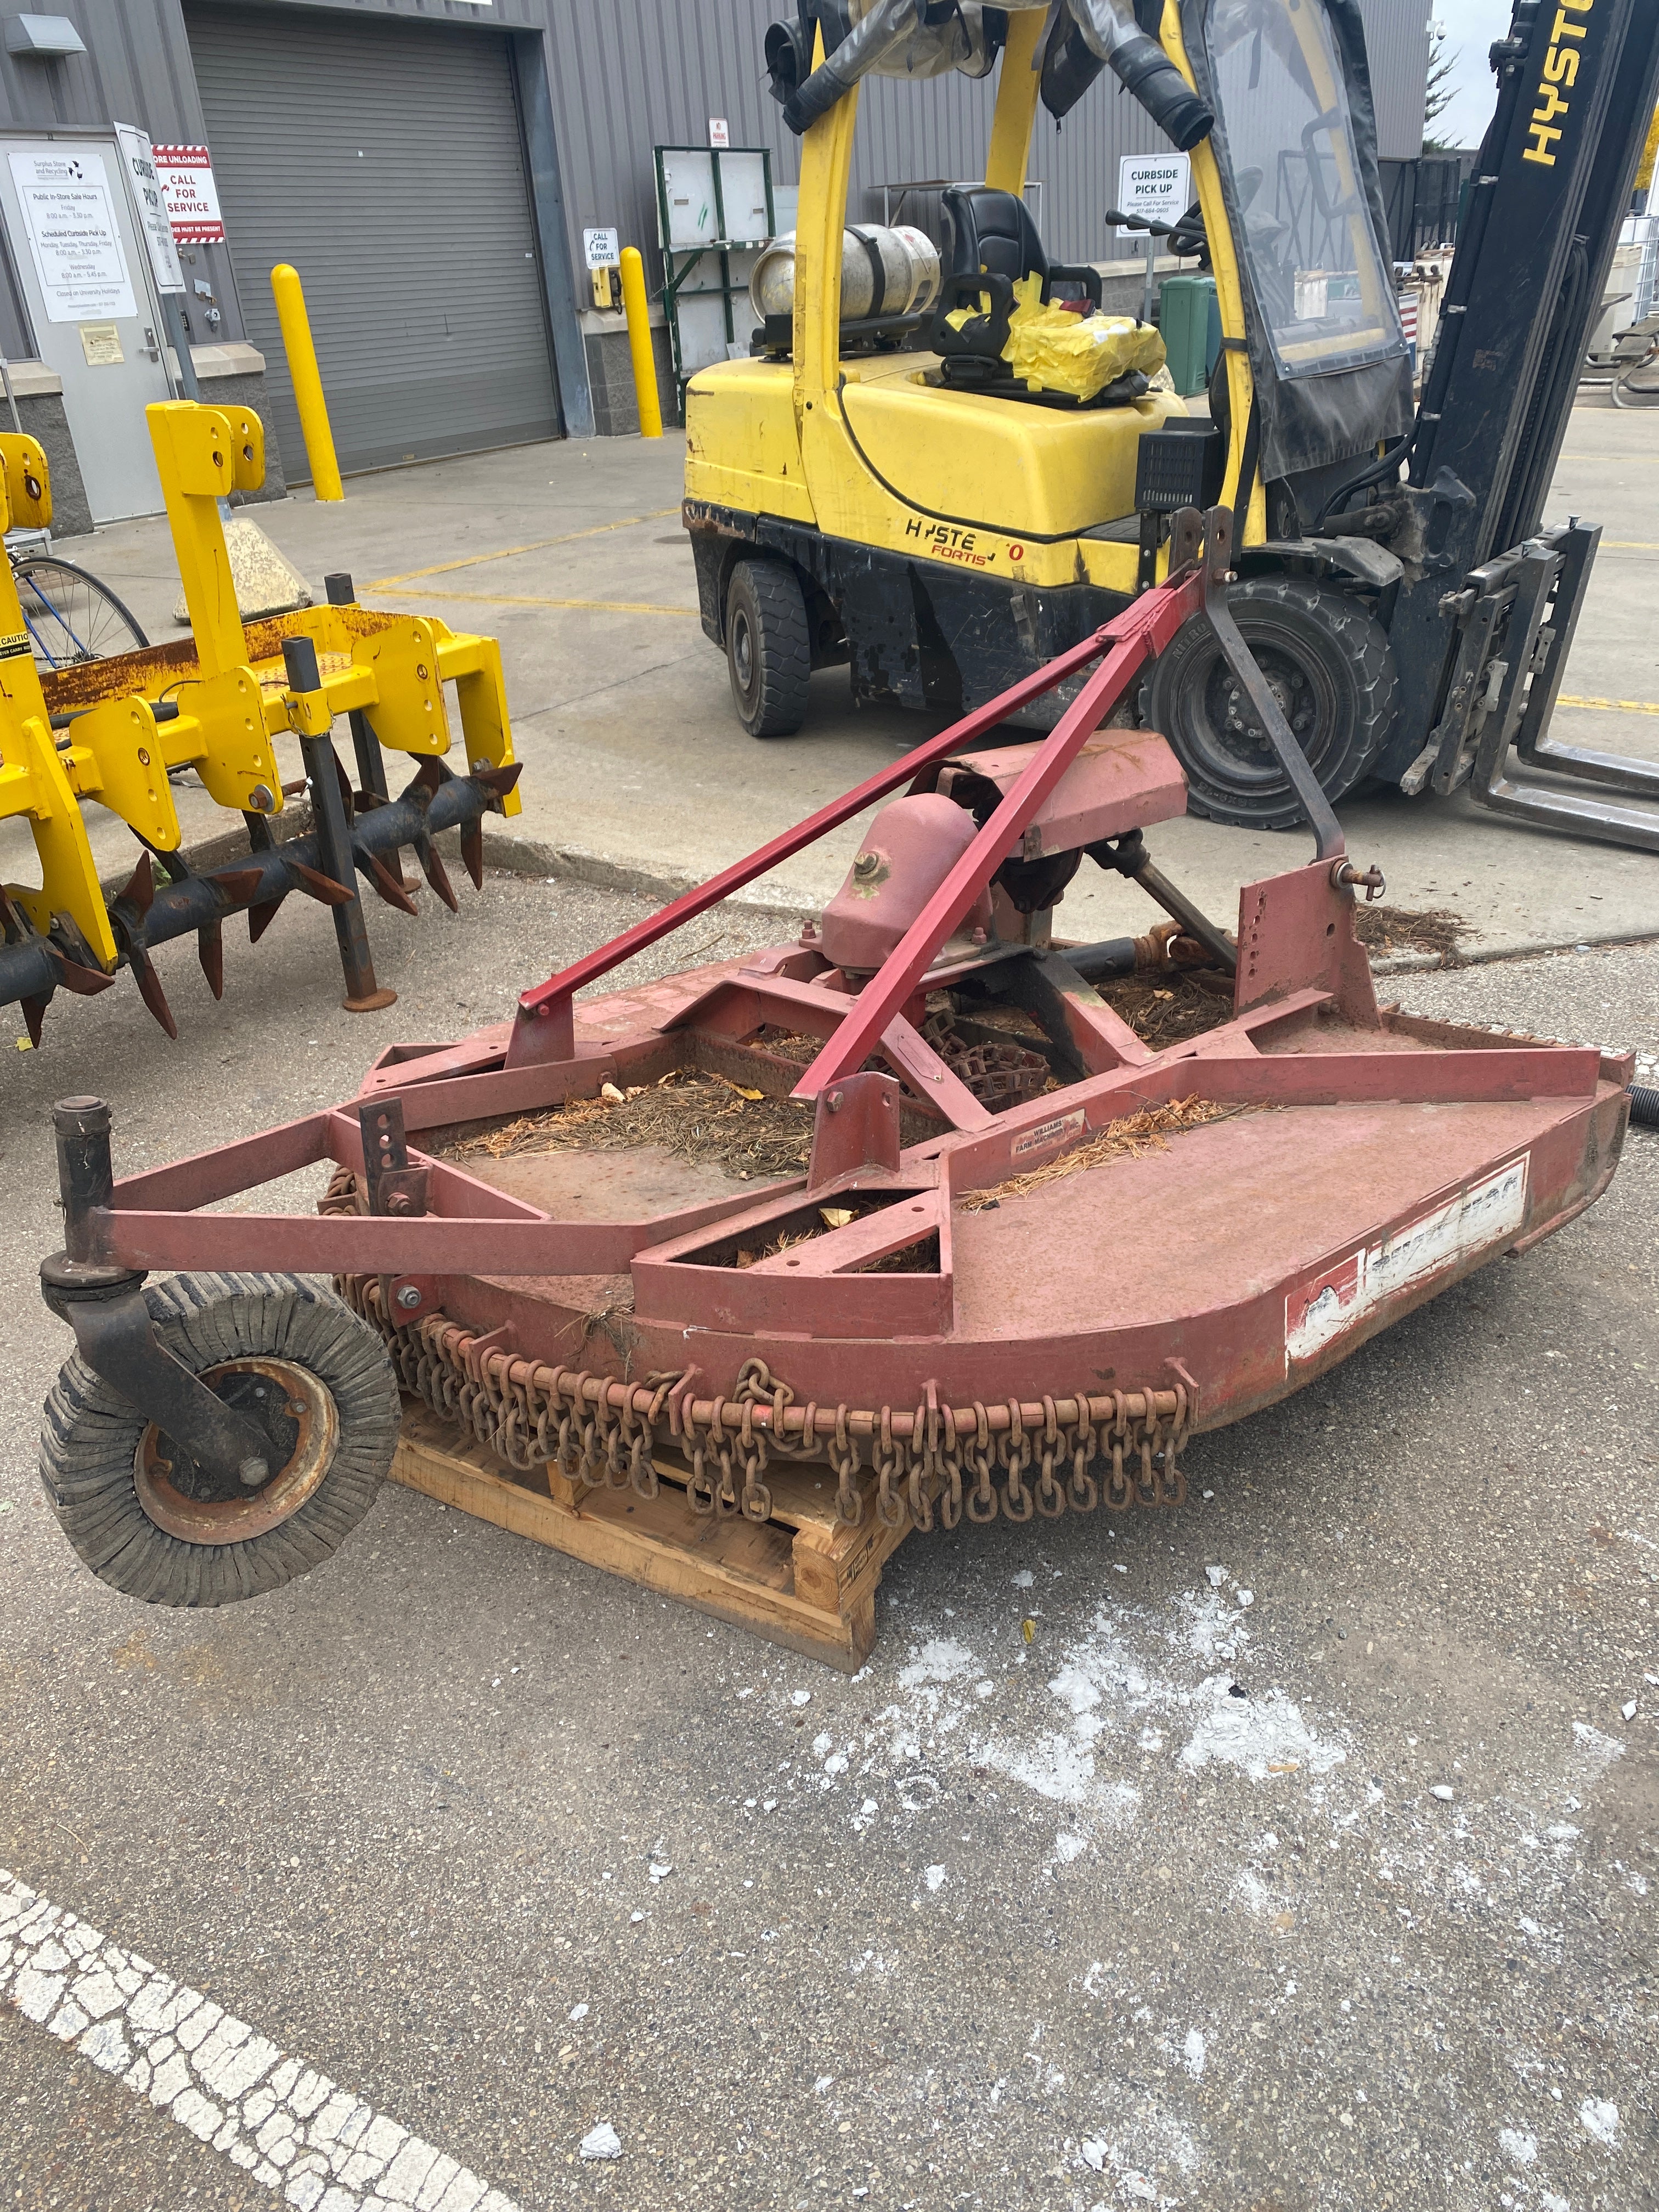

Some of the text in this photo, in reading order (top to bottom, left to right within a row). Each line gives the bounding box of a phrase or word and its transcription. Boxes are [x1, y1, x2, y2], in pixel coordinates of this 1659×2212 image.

[1523, 0, 1593, 166] HYST
[168, 156, 207, 164] UNLOADING
[170, 175, 196, 185] CALL
[1131, 169, 1178, 180] CURBSIDE
[176, 189, 196, 199] FOR
[1136, 184, 1172, 194] PICK UP
[167, 202, 209, 212] SERVICE
[591, 252, 614, 261] SERVICE
[905, 518, 996, 561] HYSTE
[931, 544, 988, 566] FORTIS
[1, 633, 29, 645] CAUTIO
[1172, 623, 1206, 659] NITRO
[1016, 1141, 1032, 1153] FARM
[1034, 1127, 1067, 1145] MACHINERY
